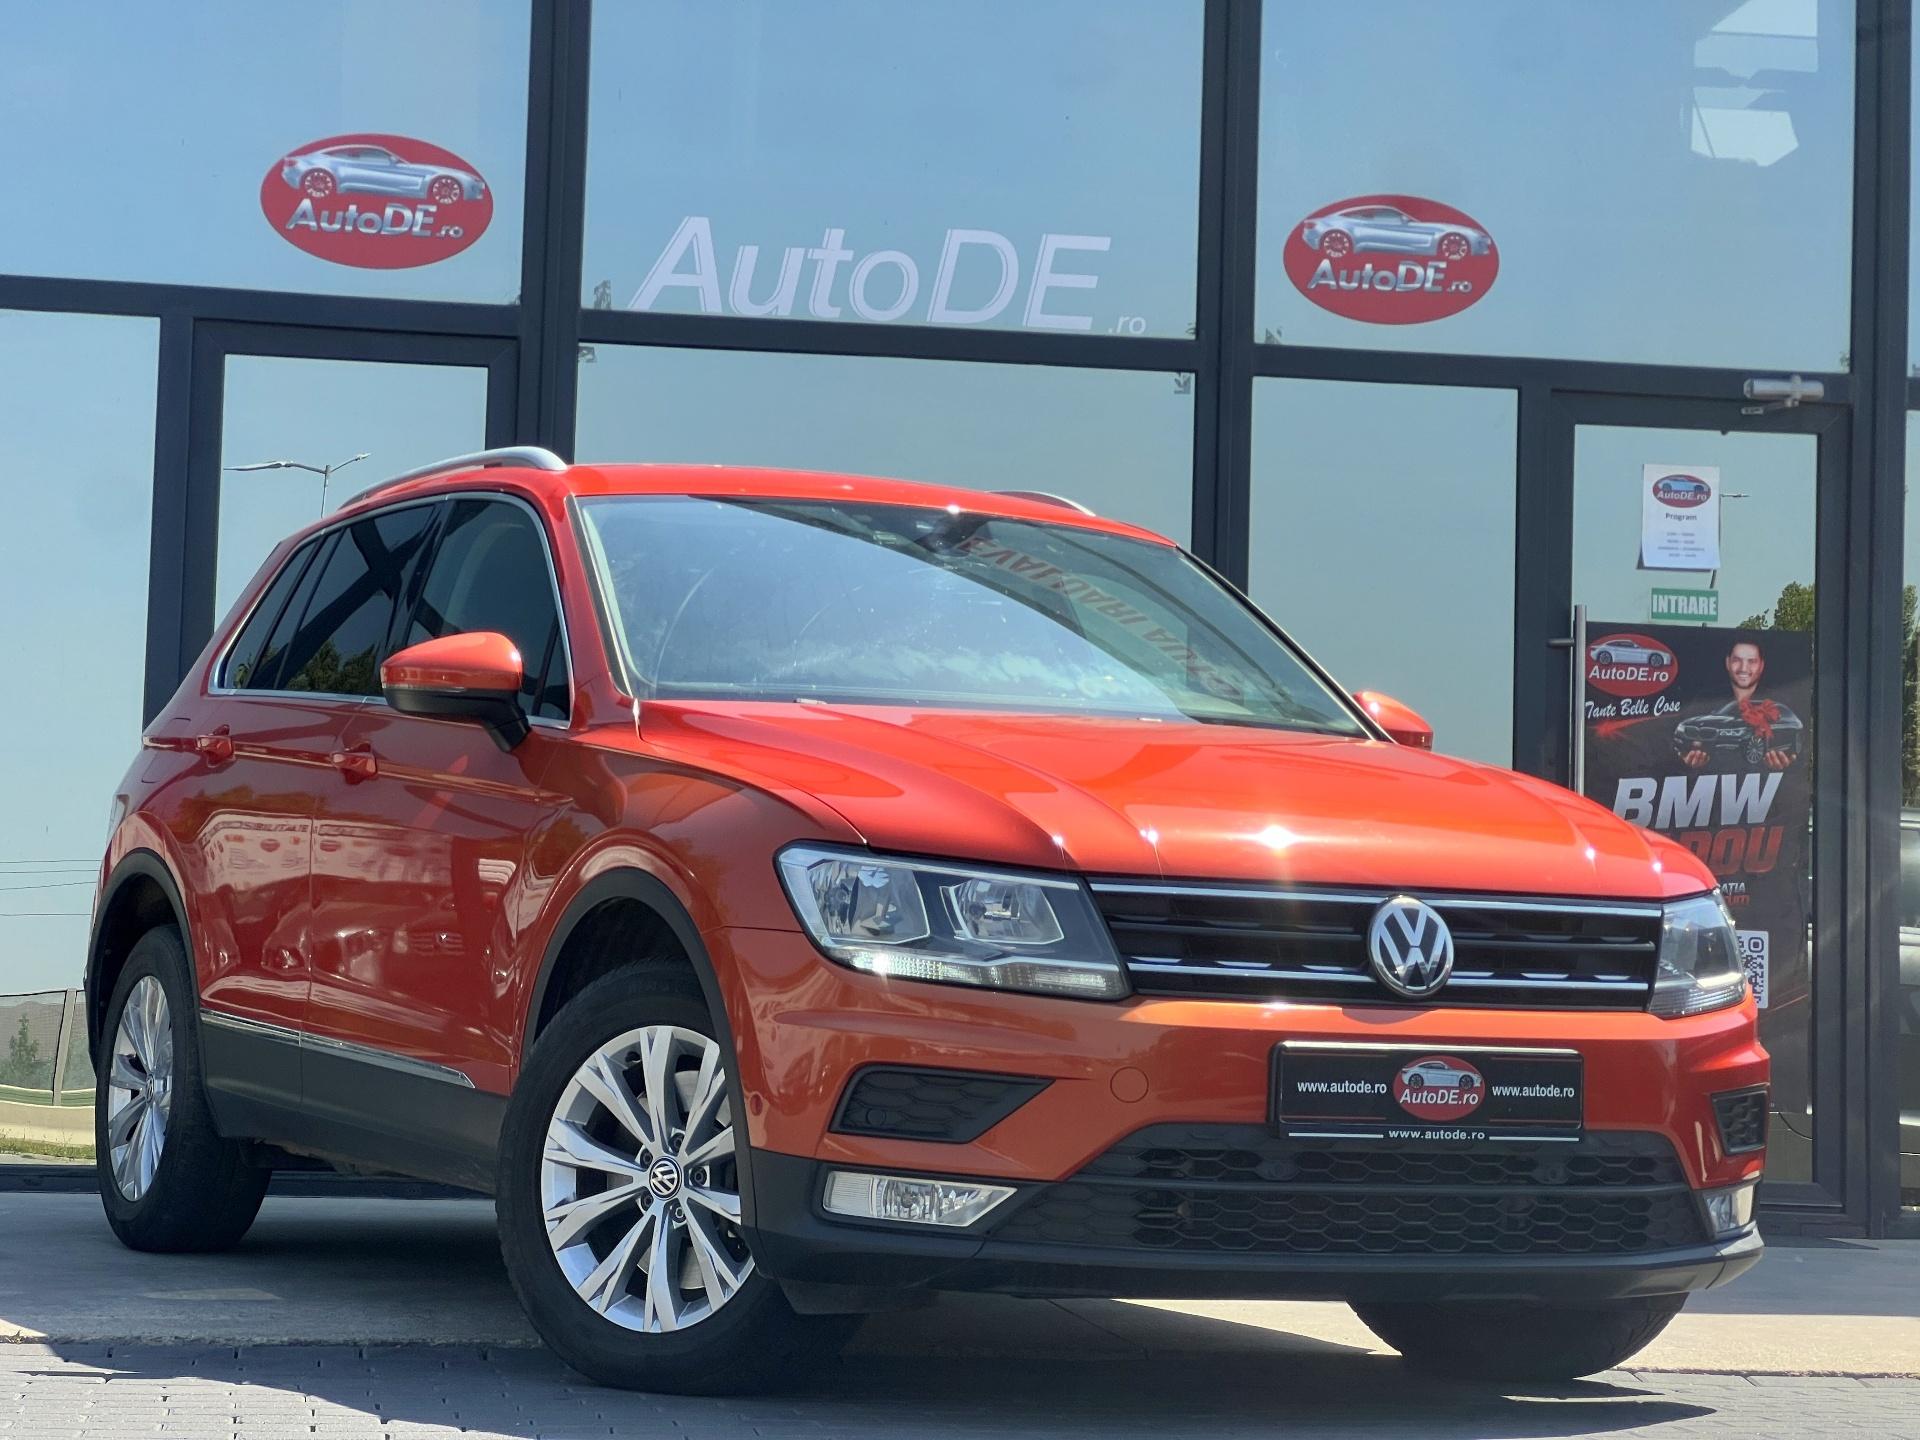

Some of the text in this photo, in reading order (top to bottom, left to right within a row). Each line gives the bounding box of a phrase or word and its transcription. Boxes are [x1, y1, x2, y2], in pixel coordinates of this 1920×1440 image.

[1657, 490, 1707, 501] AutoDE.ro
[1665, 513, 1697, 521] Program
[1652, 594, 1717, 616] INTRARE
[1588, 665, 1669, 682] AutoDE.ro
[1584, 696, 1681, 719] Tante Belle Cose
[1613, 772, 1784, 829] BMW
[1666, 826, 1784, 876] DOU
[1297, 1081, 1388, 1095] www.autode.ro
[1491, 1084, 1575, 1098] www.autode.ro
[1399, 1089, 1479, 1105] AutoDE.ro
[1388, 1129, 1486, 1141] www.autode.ro
